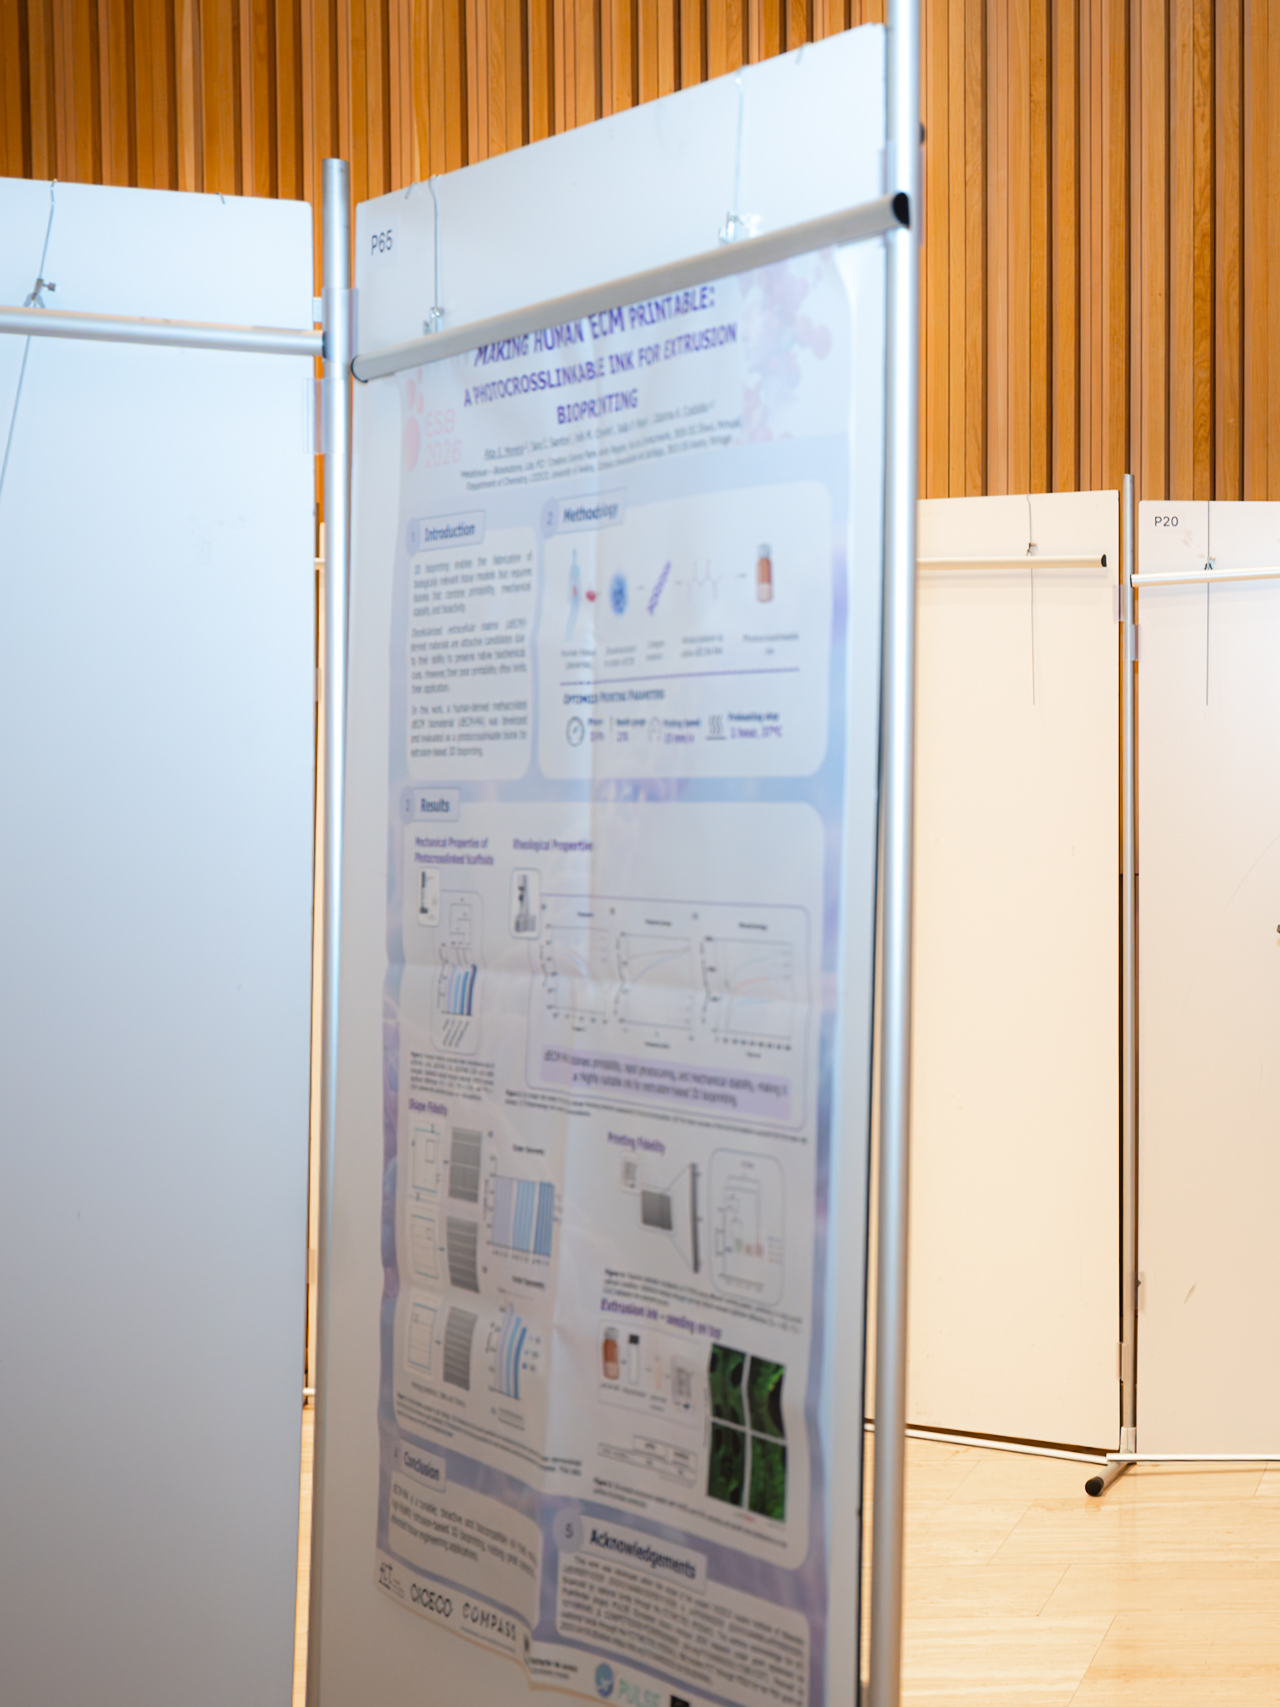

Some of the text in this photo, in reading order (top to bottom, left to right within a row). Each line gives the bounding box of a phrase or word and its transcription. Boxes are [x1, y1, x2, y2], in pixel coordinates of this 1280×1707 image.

[371, 229, 393, 256] P65
[473, 286, 715, 367] MAKING HUMAN ECM PRINTABLE:
[464, 322, 738, 408] A PHOTOCROSSLINKABLE INK FOR EXTRUSION
[557, 388, 638, 425] BIOPRINTING
[426, 409, 455, 437] ESB
[425, 438, 462, 468] 2026
[562, 502, 619, 524] Methodology
[1154, 516, 1179, 527] P20
[424, 521, 475, 543] Introduction
[420, 798, 450, 813] Results
[601, 1298, 644, 1317] Extrusion
[403, 1451, 440, 1482] Conclusion
[590, 1529, 697, 1580] Acknowledgements
[462, 1602, 517, 1641] COMPASS
